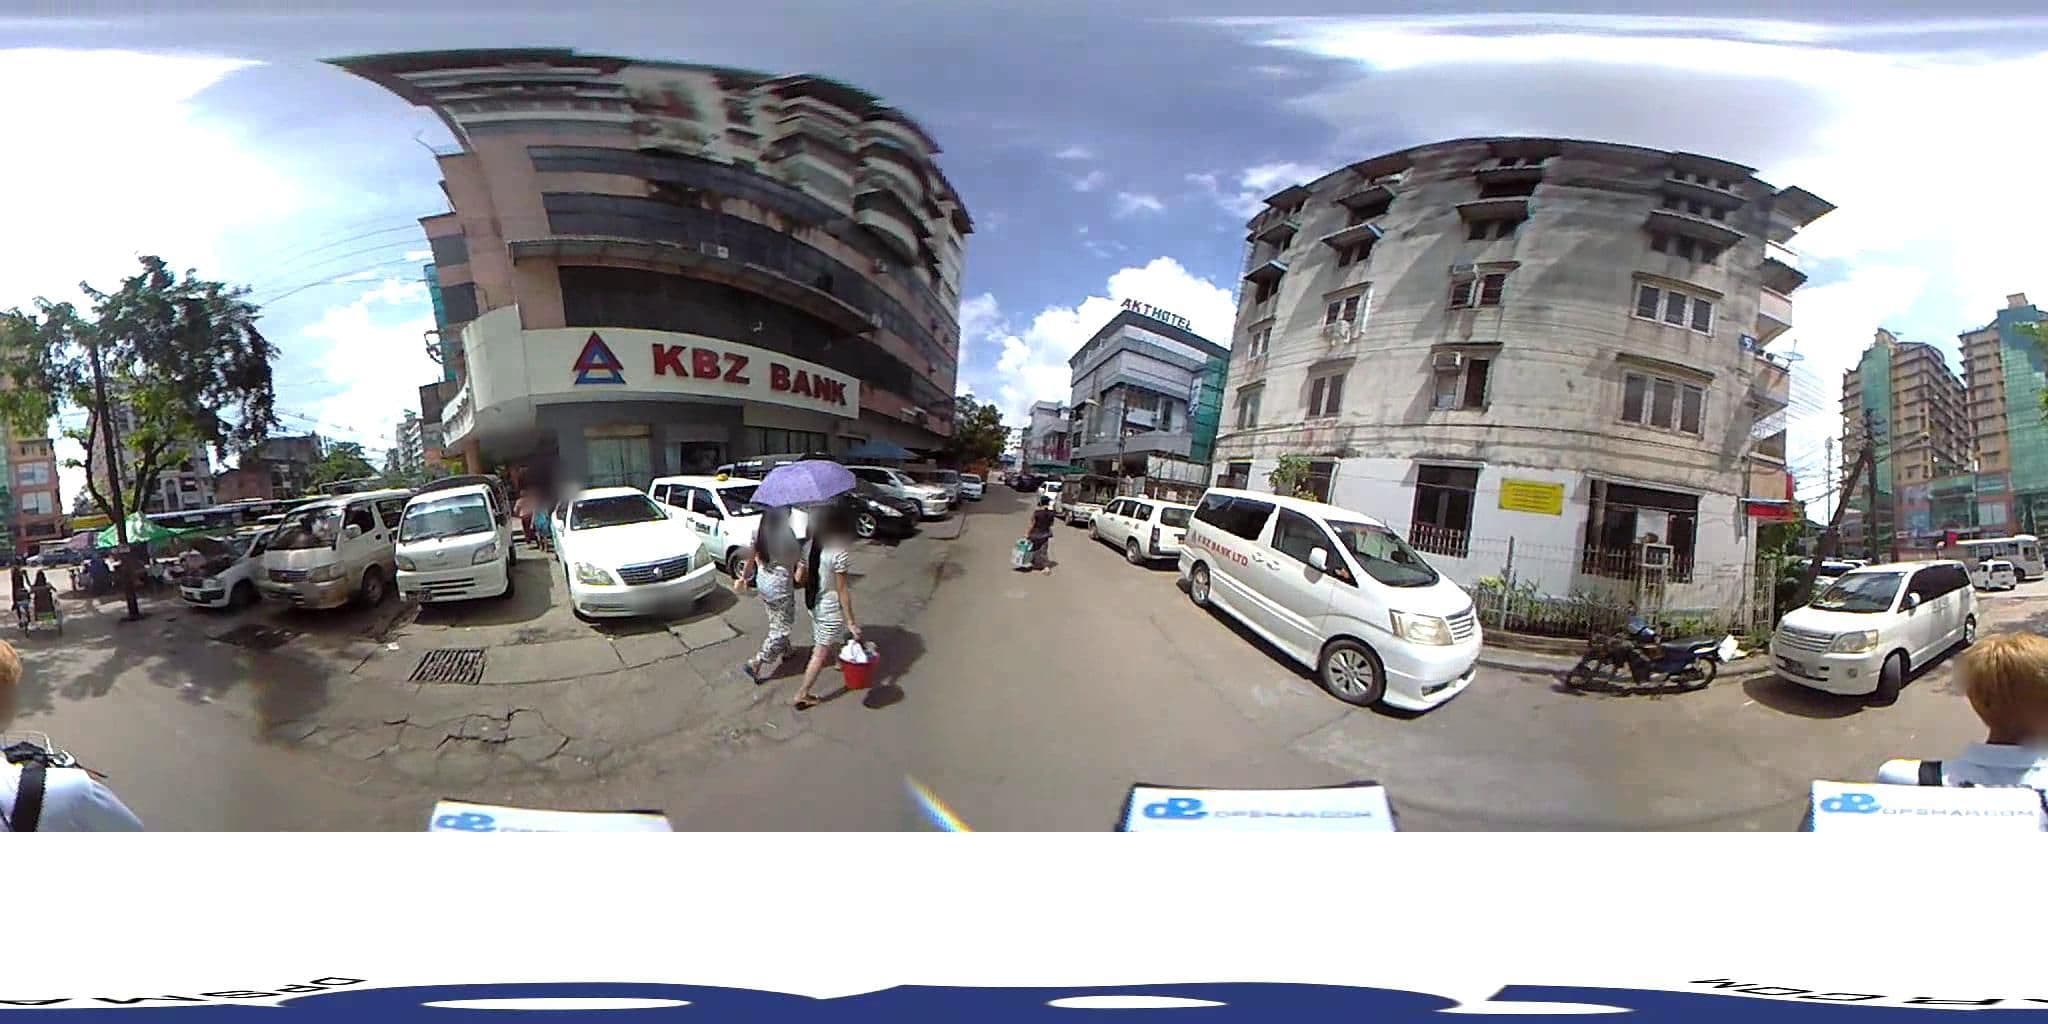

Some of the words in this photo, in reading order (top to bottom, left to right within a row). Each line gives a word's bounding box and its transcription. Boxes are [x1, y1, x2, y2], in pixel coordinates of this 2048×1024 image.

[1120, 298, 1152, 315] AKT
[1151, 306, 1192, 331] HOTEL
[652, 343, 750, 385] KBZ
[769, 362, 847, 406] BANK
[1210, 541, 1232, 558] BANK
[1232, 552, 1249, 567] LTD
